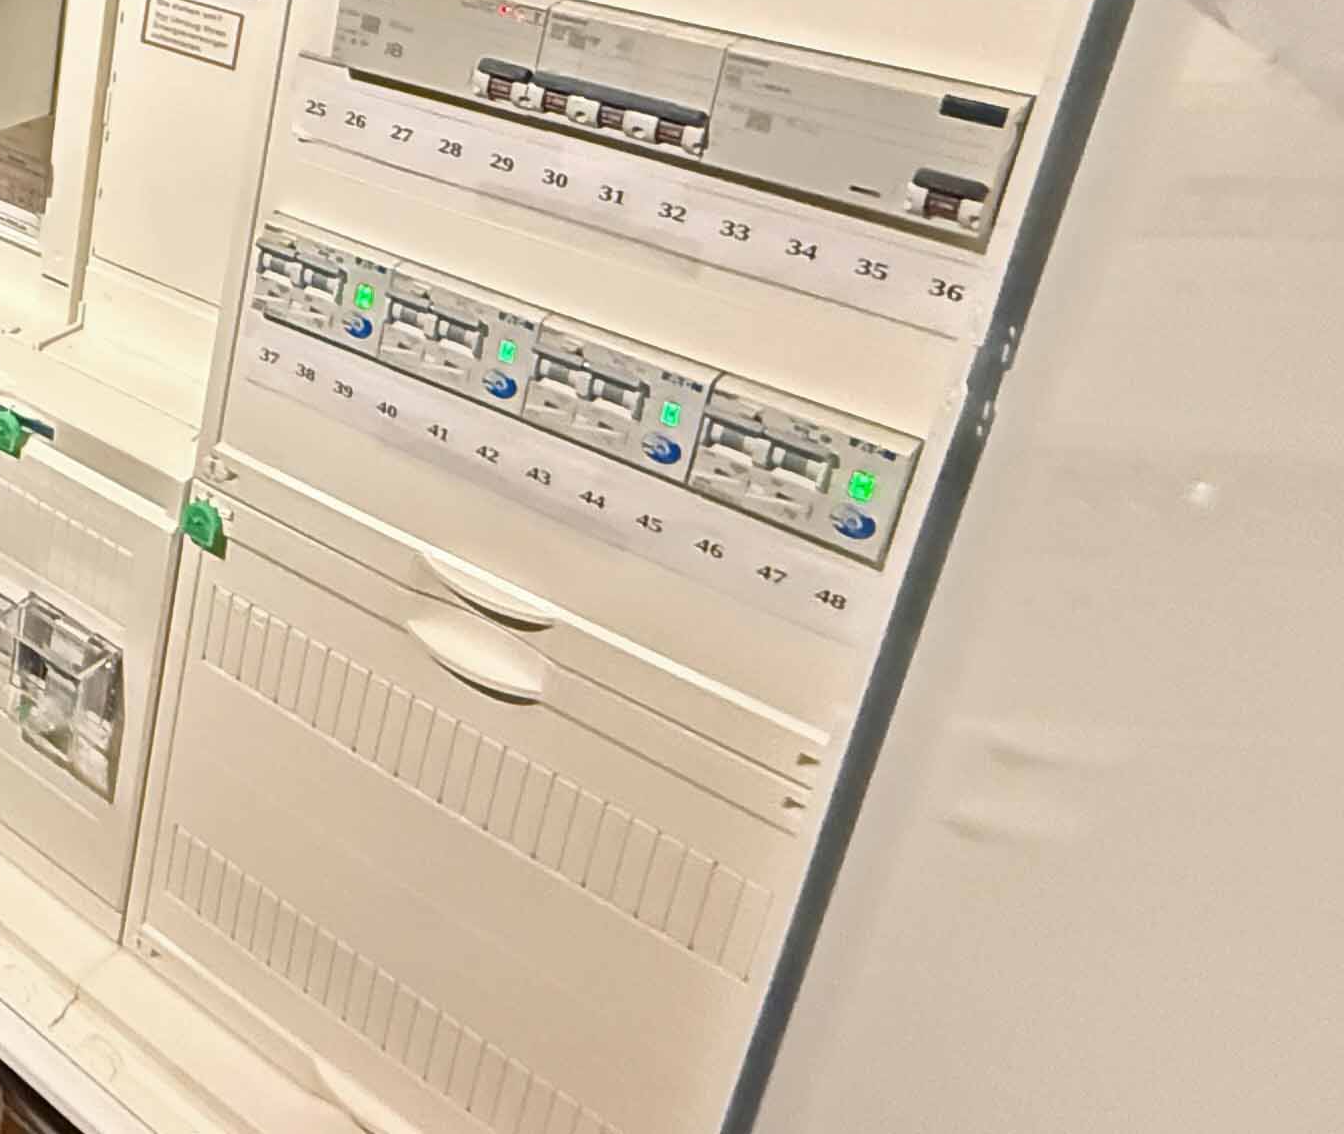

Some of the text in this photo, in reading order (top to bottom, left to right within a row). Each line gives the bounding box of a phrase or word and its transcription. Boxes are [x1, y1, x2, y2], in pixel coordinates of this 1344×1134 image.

[305, 99, 965, 302] 25 26 27 28 29 30 31 32 33 34 35 36
[259, 347, 847, 610] 37 38 39 40 41 42 43 44 45 46 47 48
